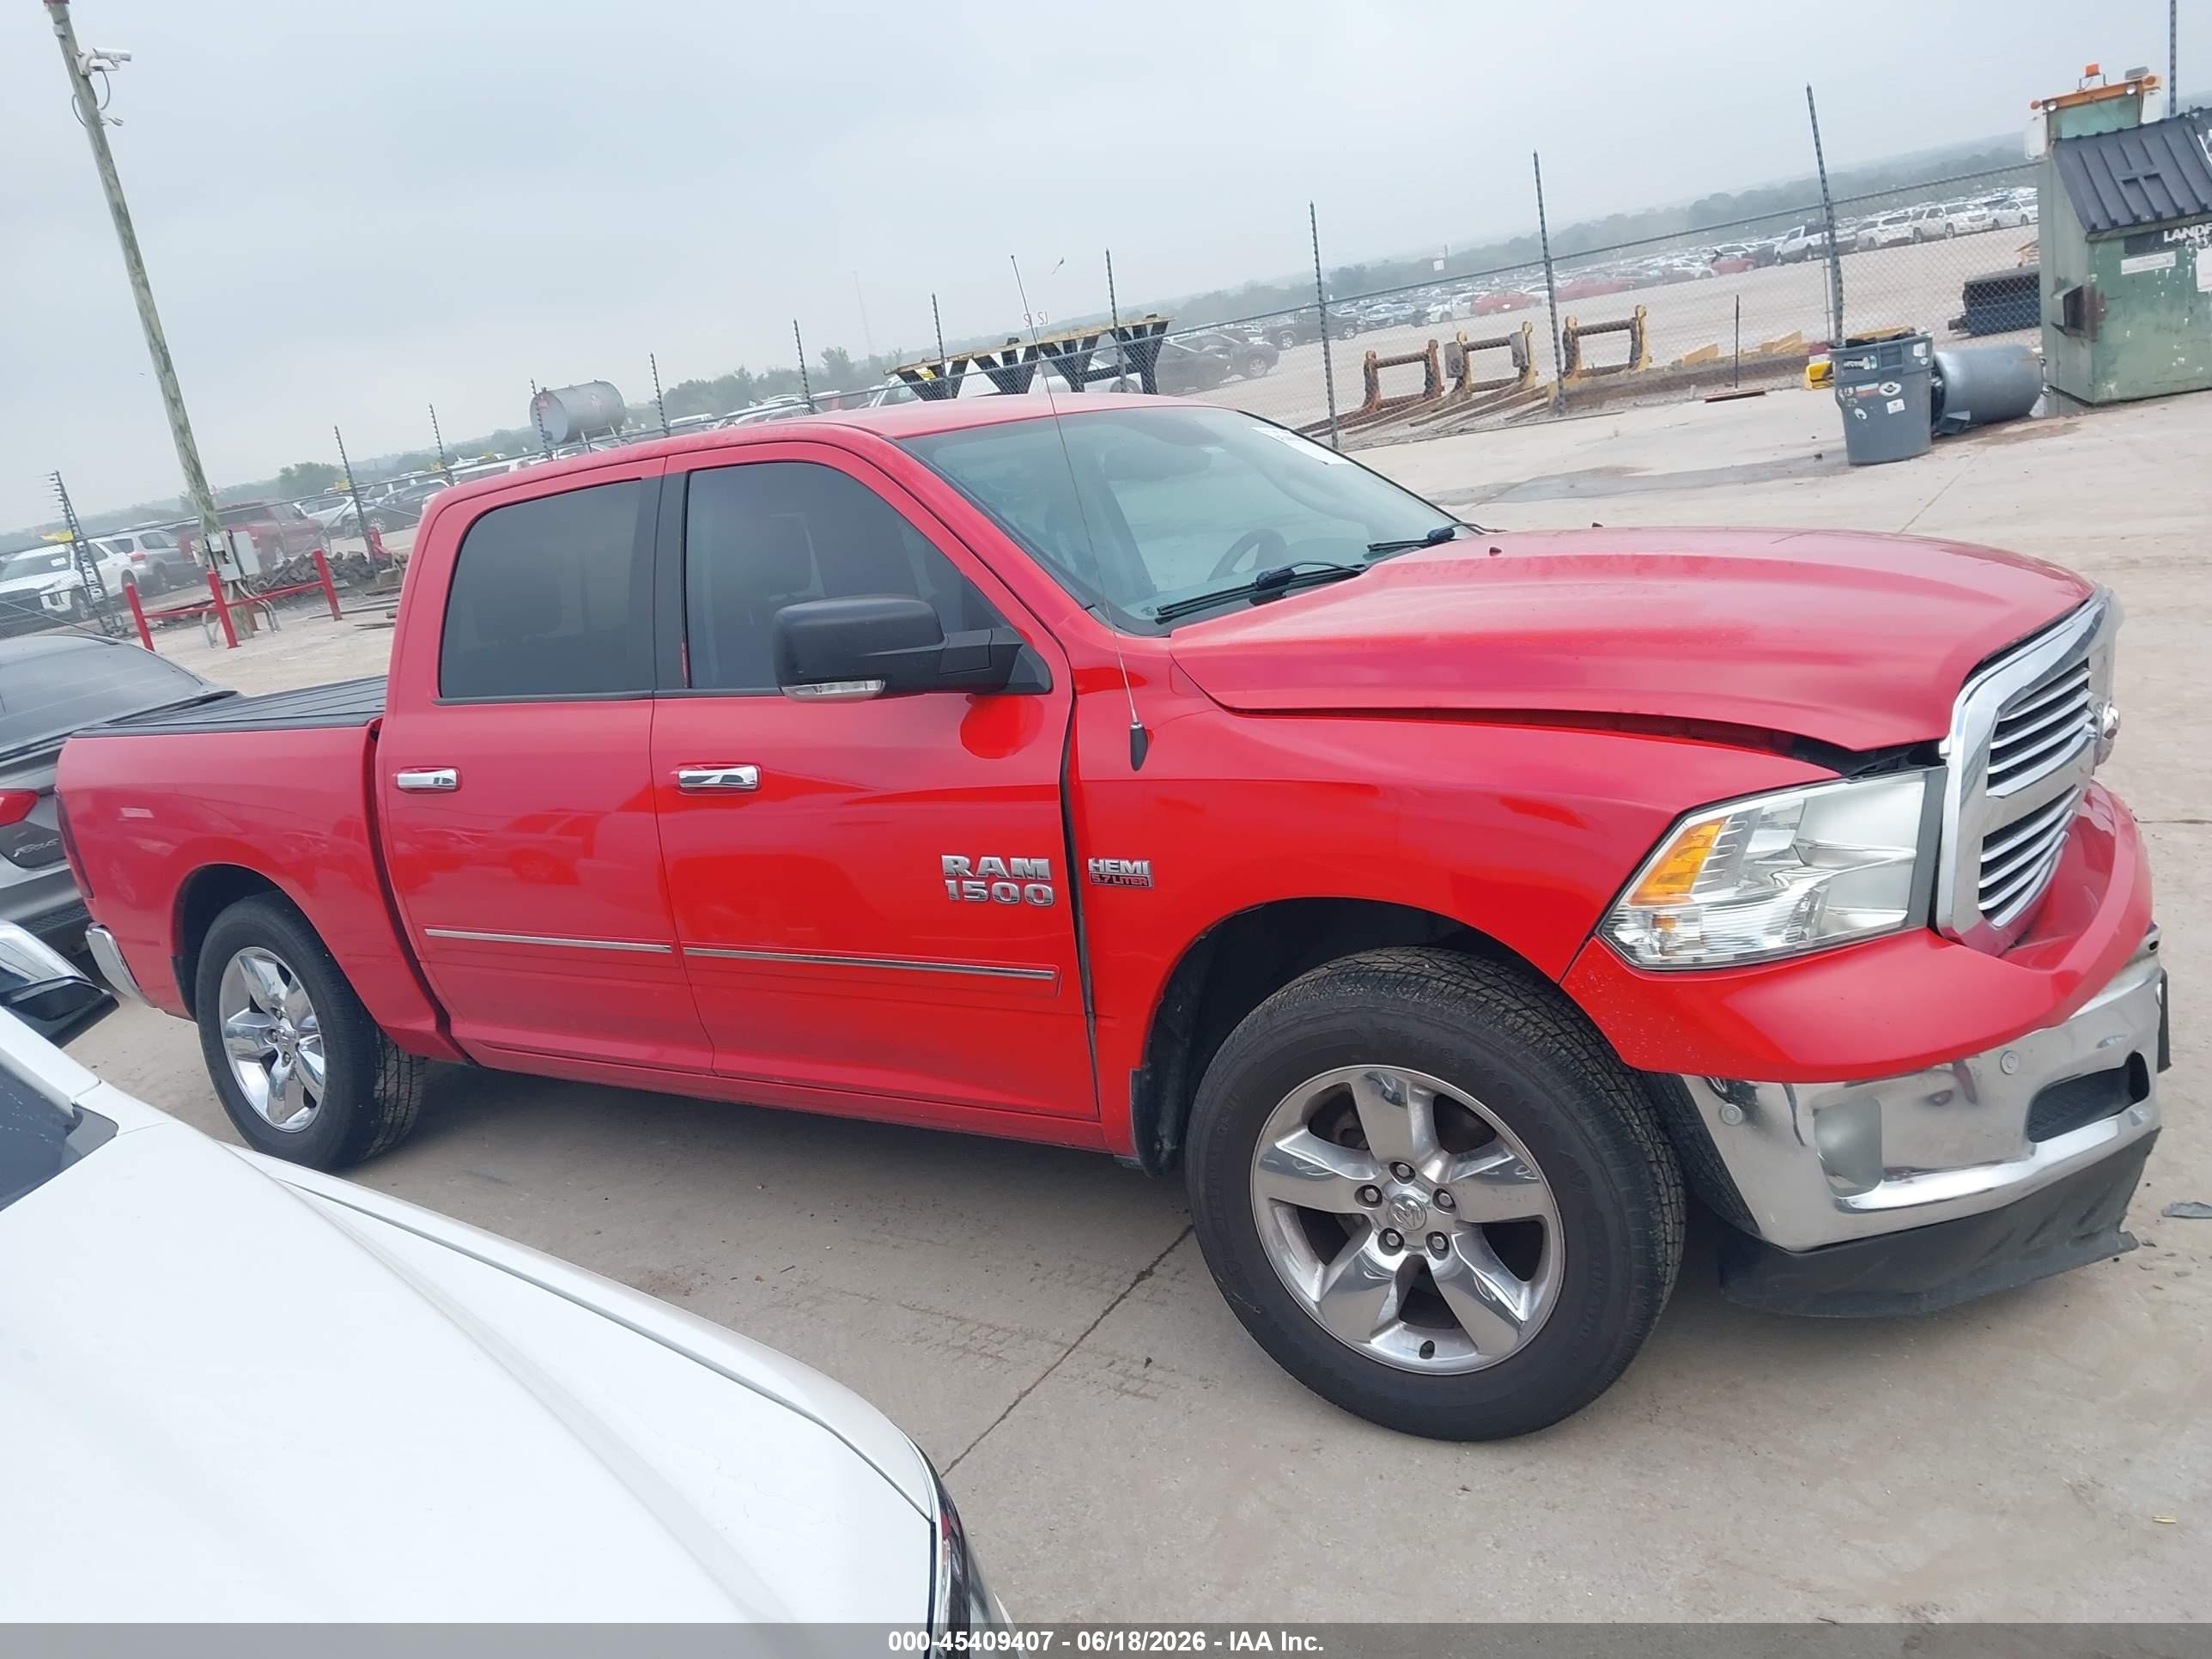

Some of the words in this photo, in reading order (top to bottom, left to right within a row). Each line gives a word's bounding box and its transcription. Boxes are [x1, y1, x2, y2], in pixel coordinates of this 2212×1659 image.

[941, 855, 1052, 880] RAM
[1088, 858, 1150, 874] HEMI
[1091, 873, 1110, 884] 5.7
[1112, 874, 1149, 886] LITER
[945, 879, 1054, 907] 1500
